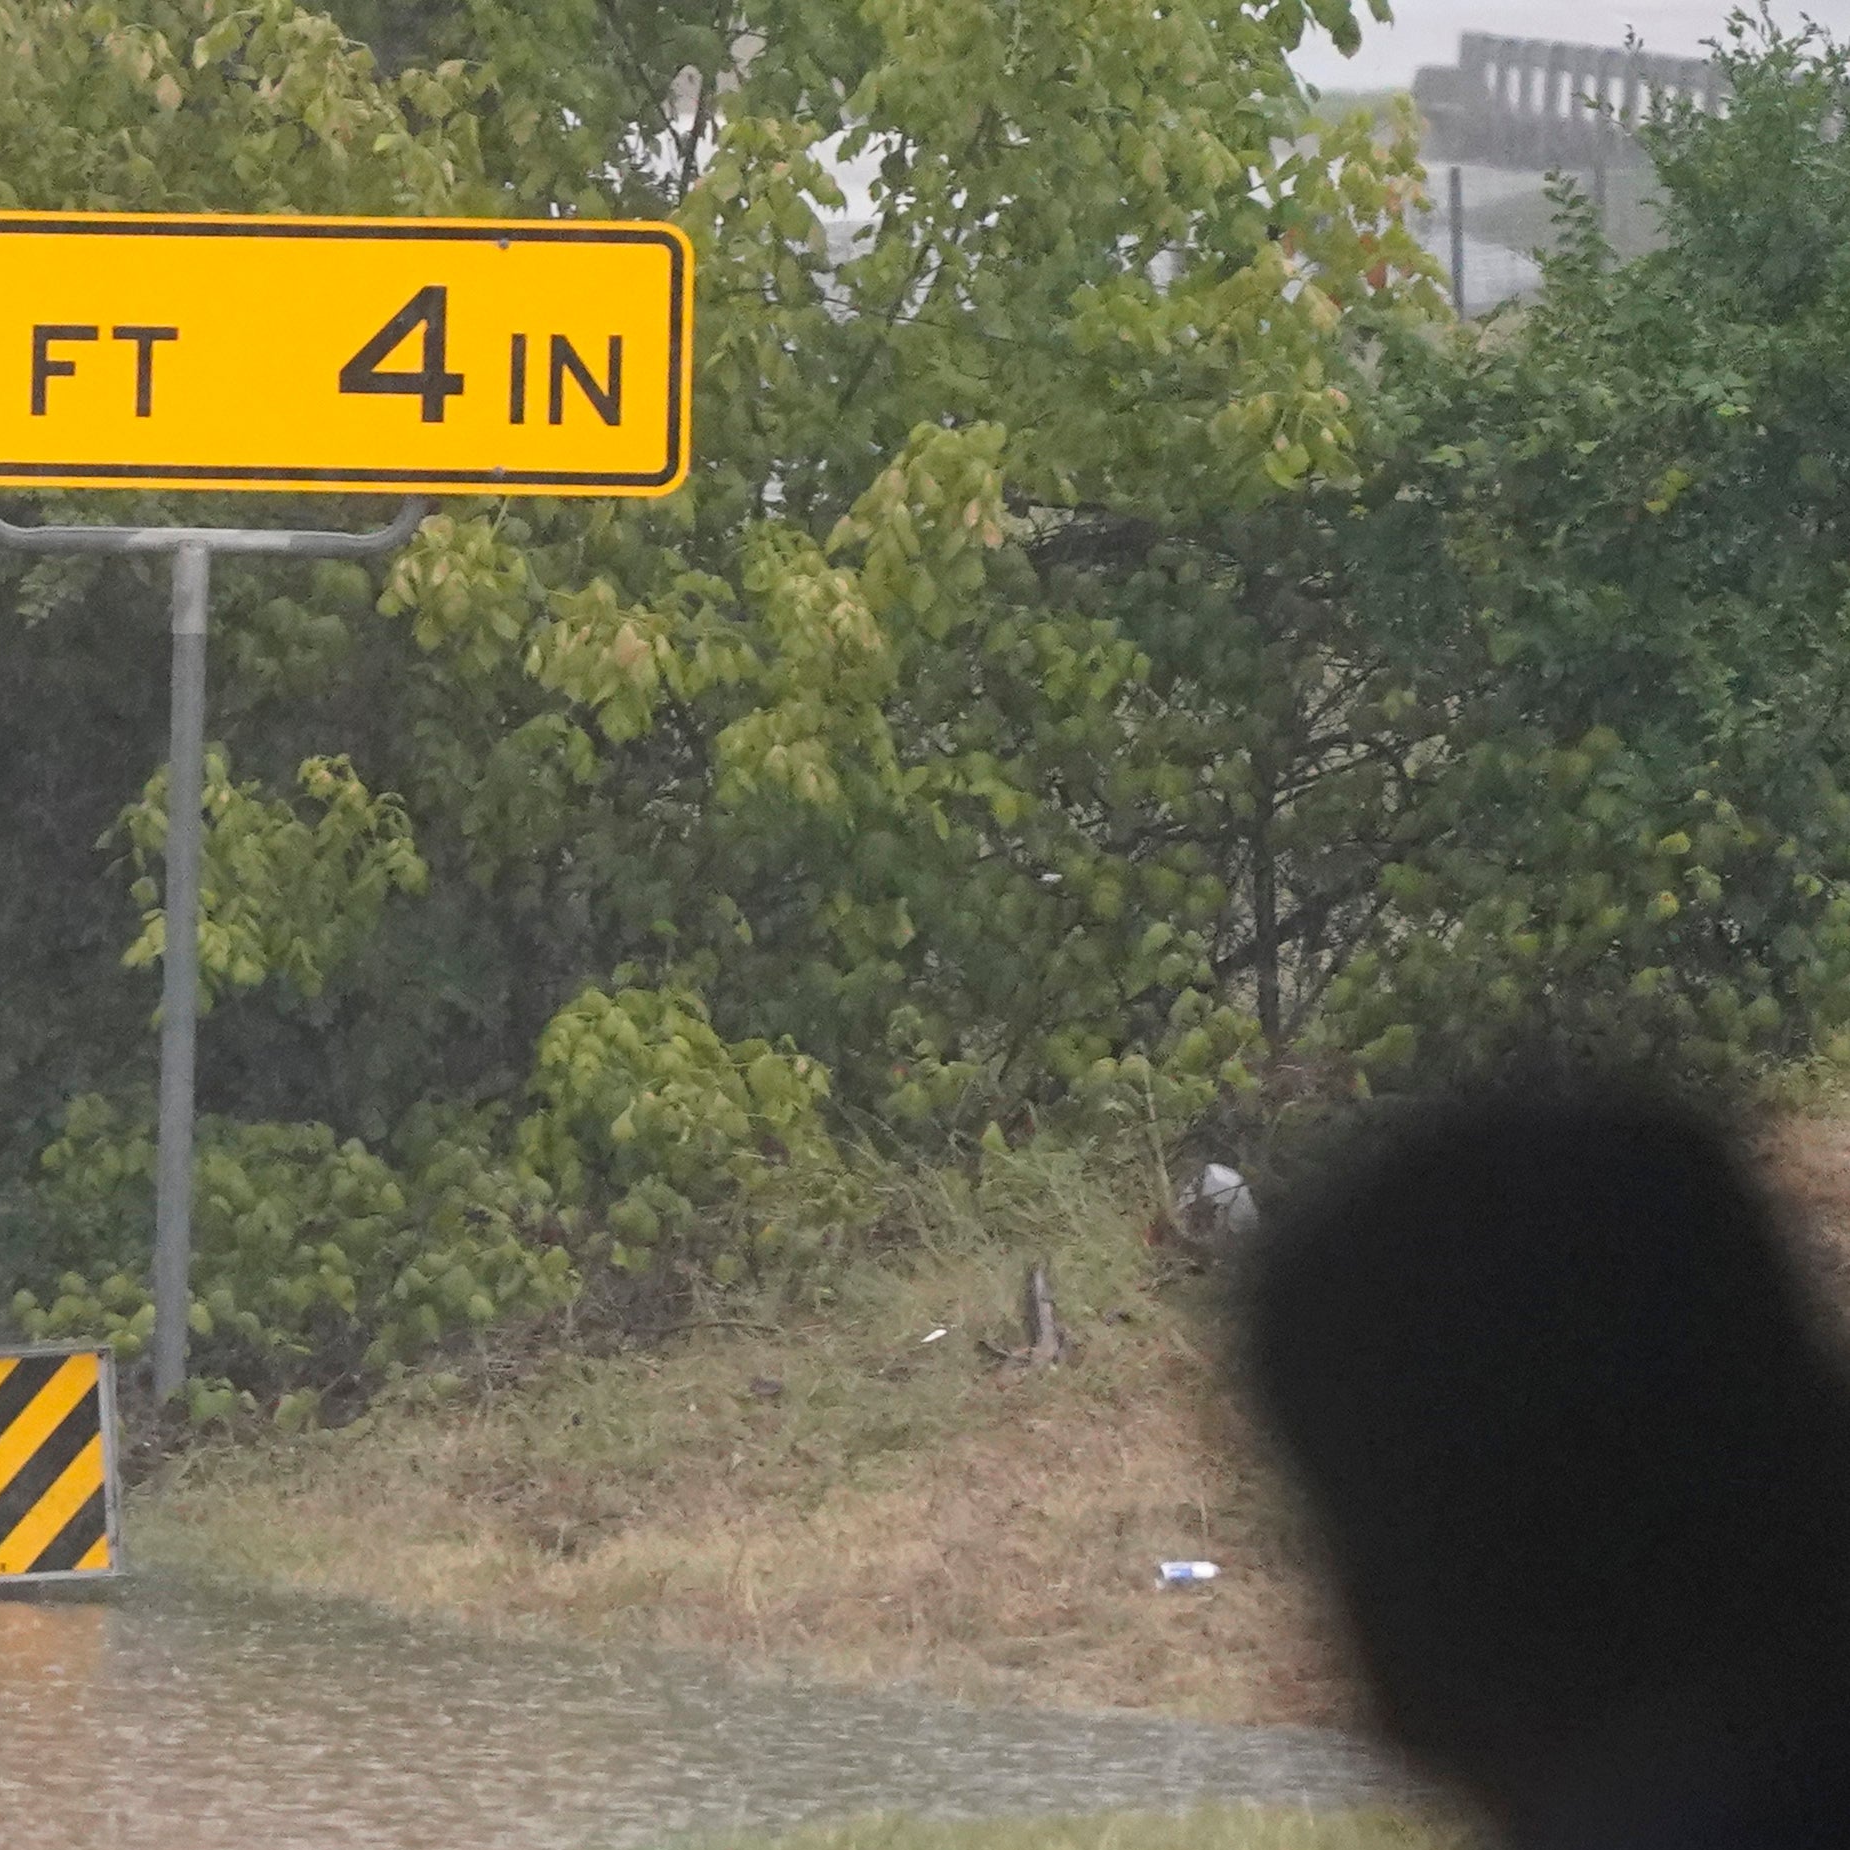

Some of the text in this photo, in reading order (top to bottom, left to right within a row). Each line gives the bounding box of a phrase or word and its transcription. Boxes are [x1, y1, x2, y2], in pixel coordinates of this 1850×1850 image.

[31, 325, 179, 417] FT
[338, 285, 465, 424] 4
[508, 333, 623, 427] IN
